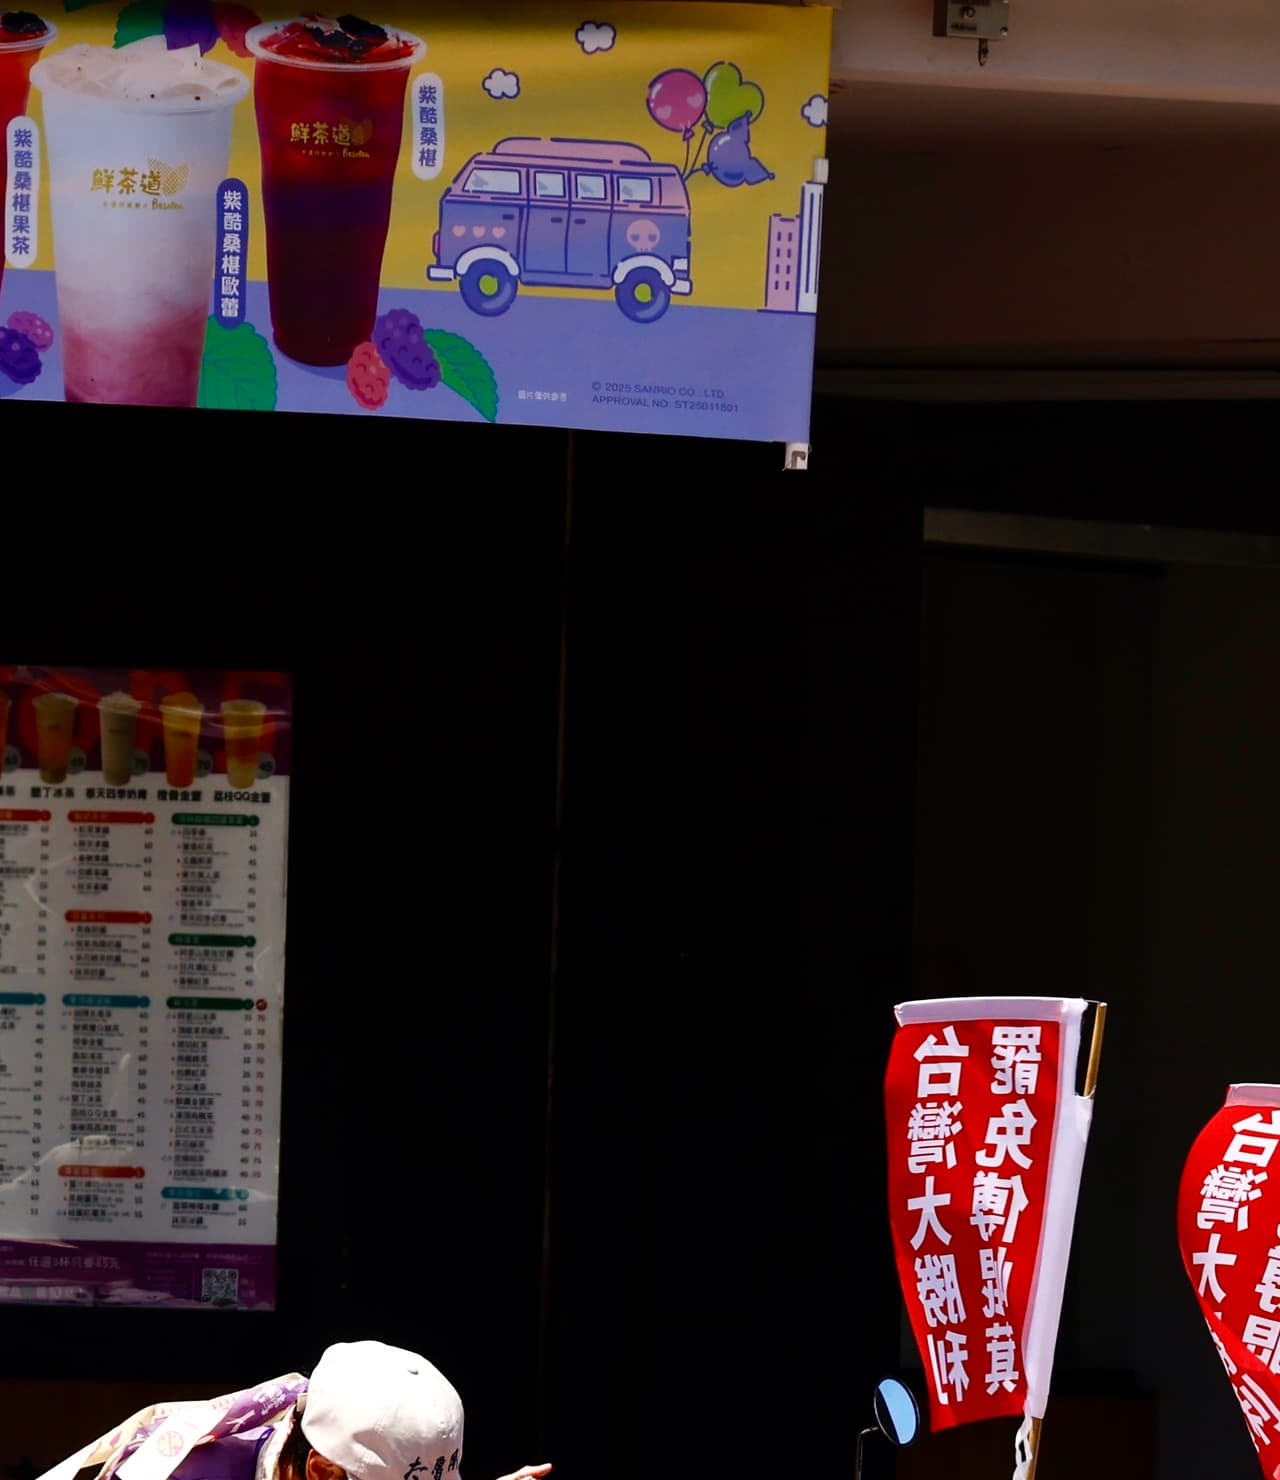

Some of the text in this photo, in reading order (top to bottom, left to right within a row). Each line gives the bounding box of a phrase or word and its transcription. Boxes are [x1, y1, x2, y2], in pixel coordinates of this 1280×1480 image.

[290, 121, 351, 147] 鮮茶道
[90, 168, 162, 196] 鮮茶道
[634, 384, 676, 395] SANRIO
[592, 395, 649, 408] APPROVAL
